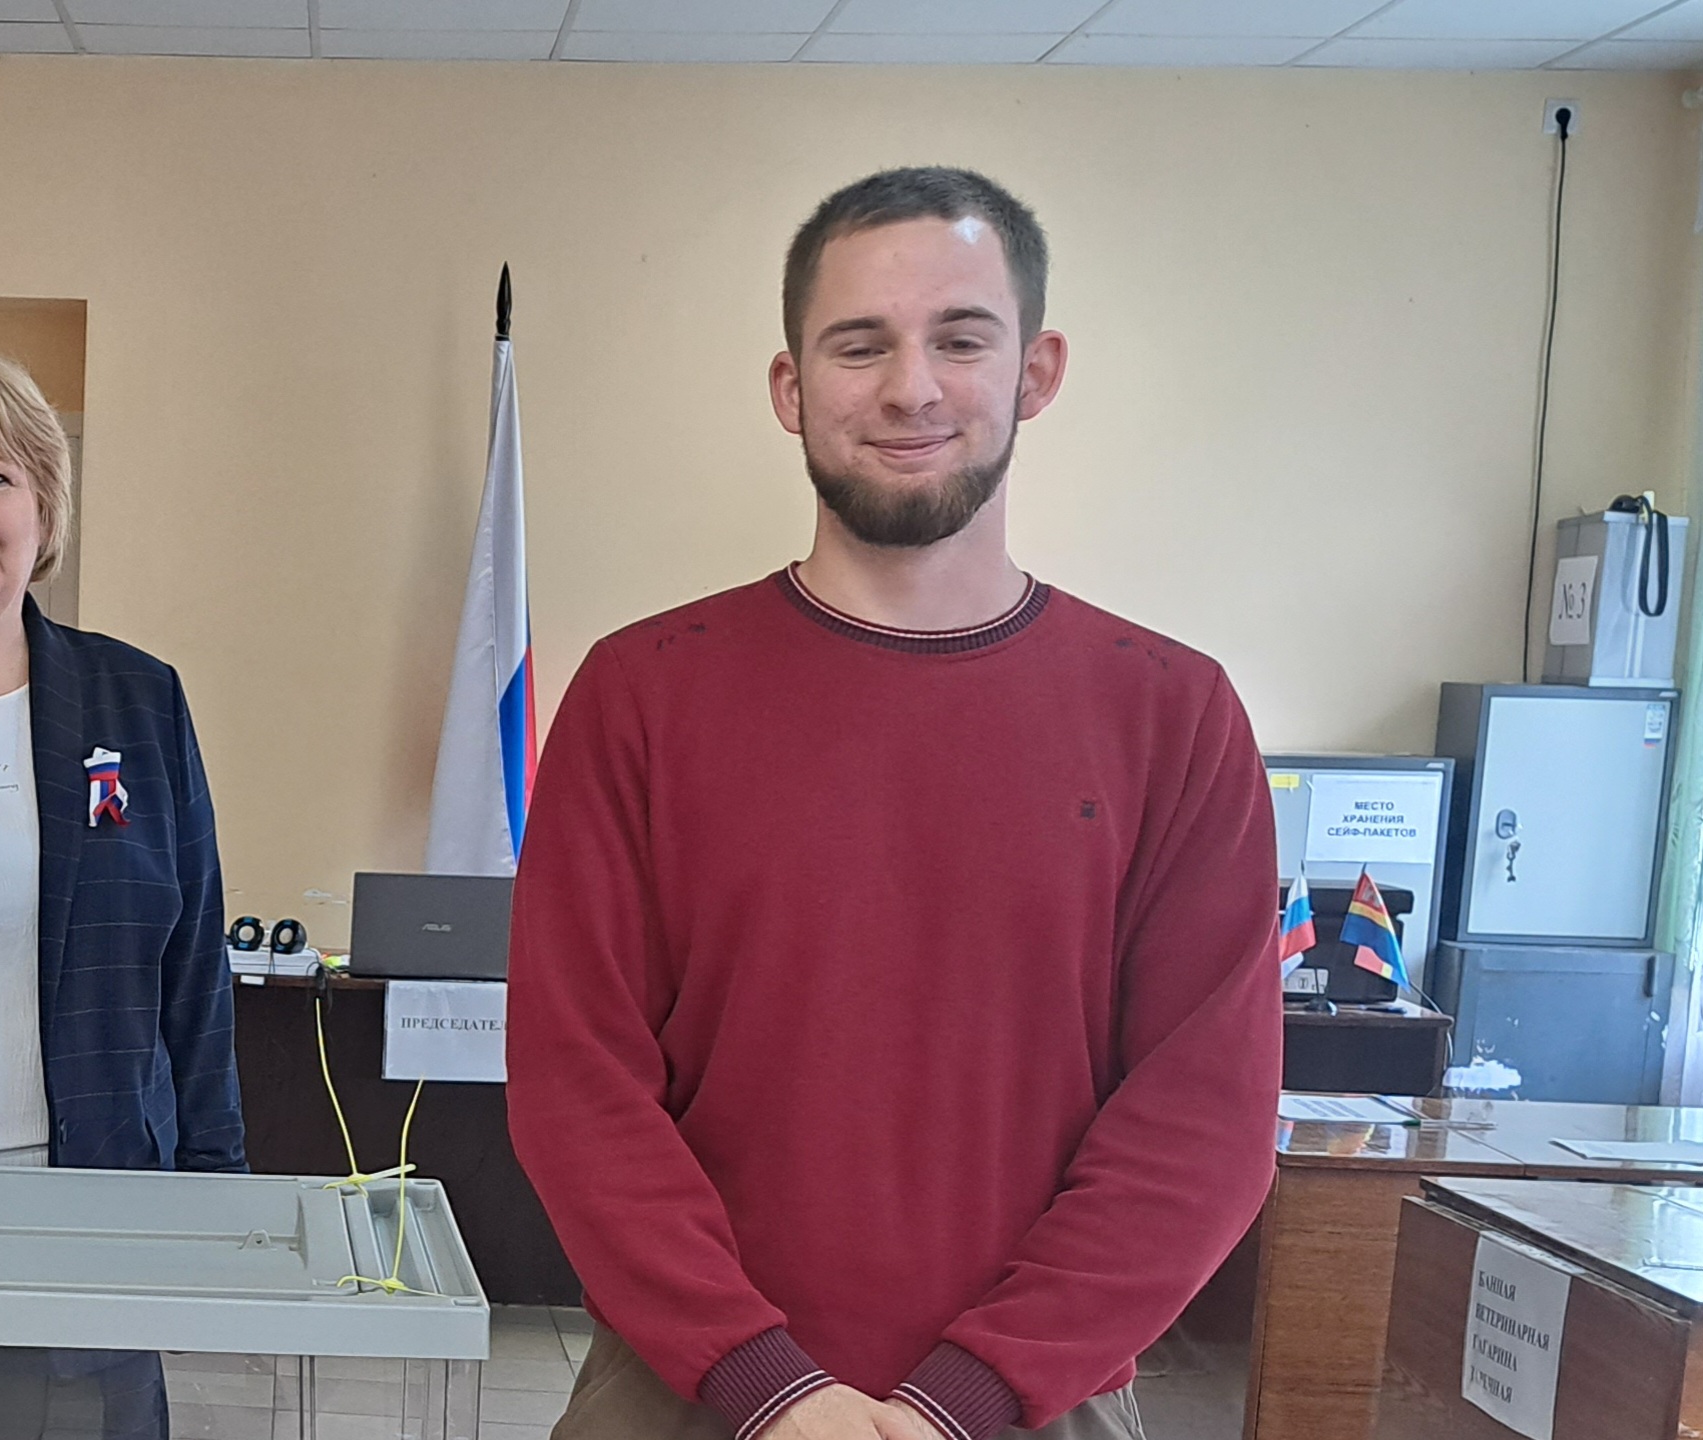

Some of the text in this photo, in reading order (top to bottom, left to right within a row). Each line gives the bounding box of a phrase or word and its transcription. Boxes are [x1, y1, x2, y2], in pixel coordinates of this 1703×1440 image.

[1354, 801, 1395, 811] МЕСТО
[1342, 814, 1405, 824] ХРАНЕНИЯ
[1327, 826, 1417, 838] СЕЙФ-ПАКЕТОВ
[1478, 1270, 1516, 1301] БАННАЯ
[1475, 1303, 1550, 1351] ВЕТЕРИНАРНАЯ
[1473, 1334, 1517, 1372] ГАГАРИНА
